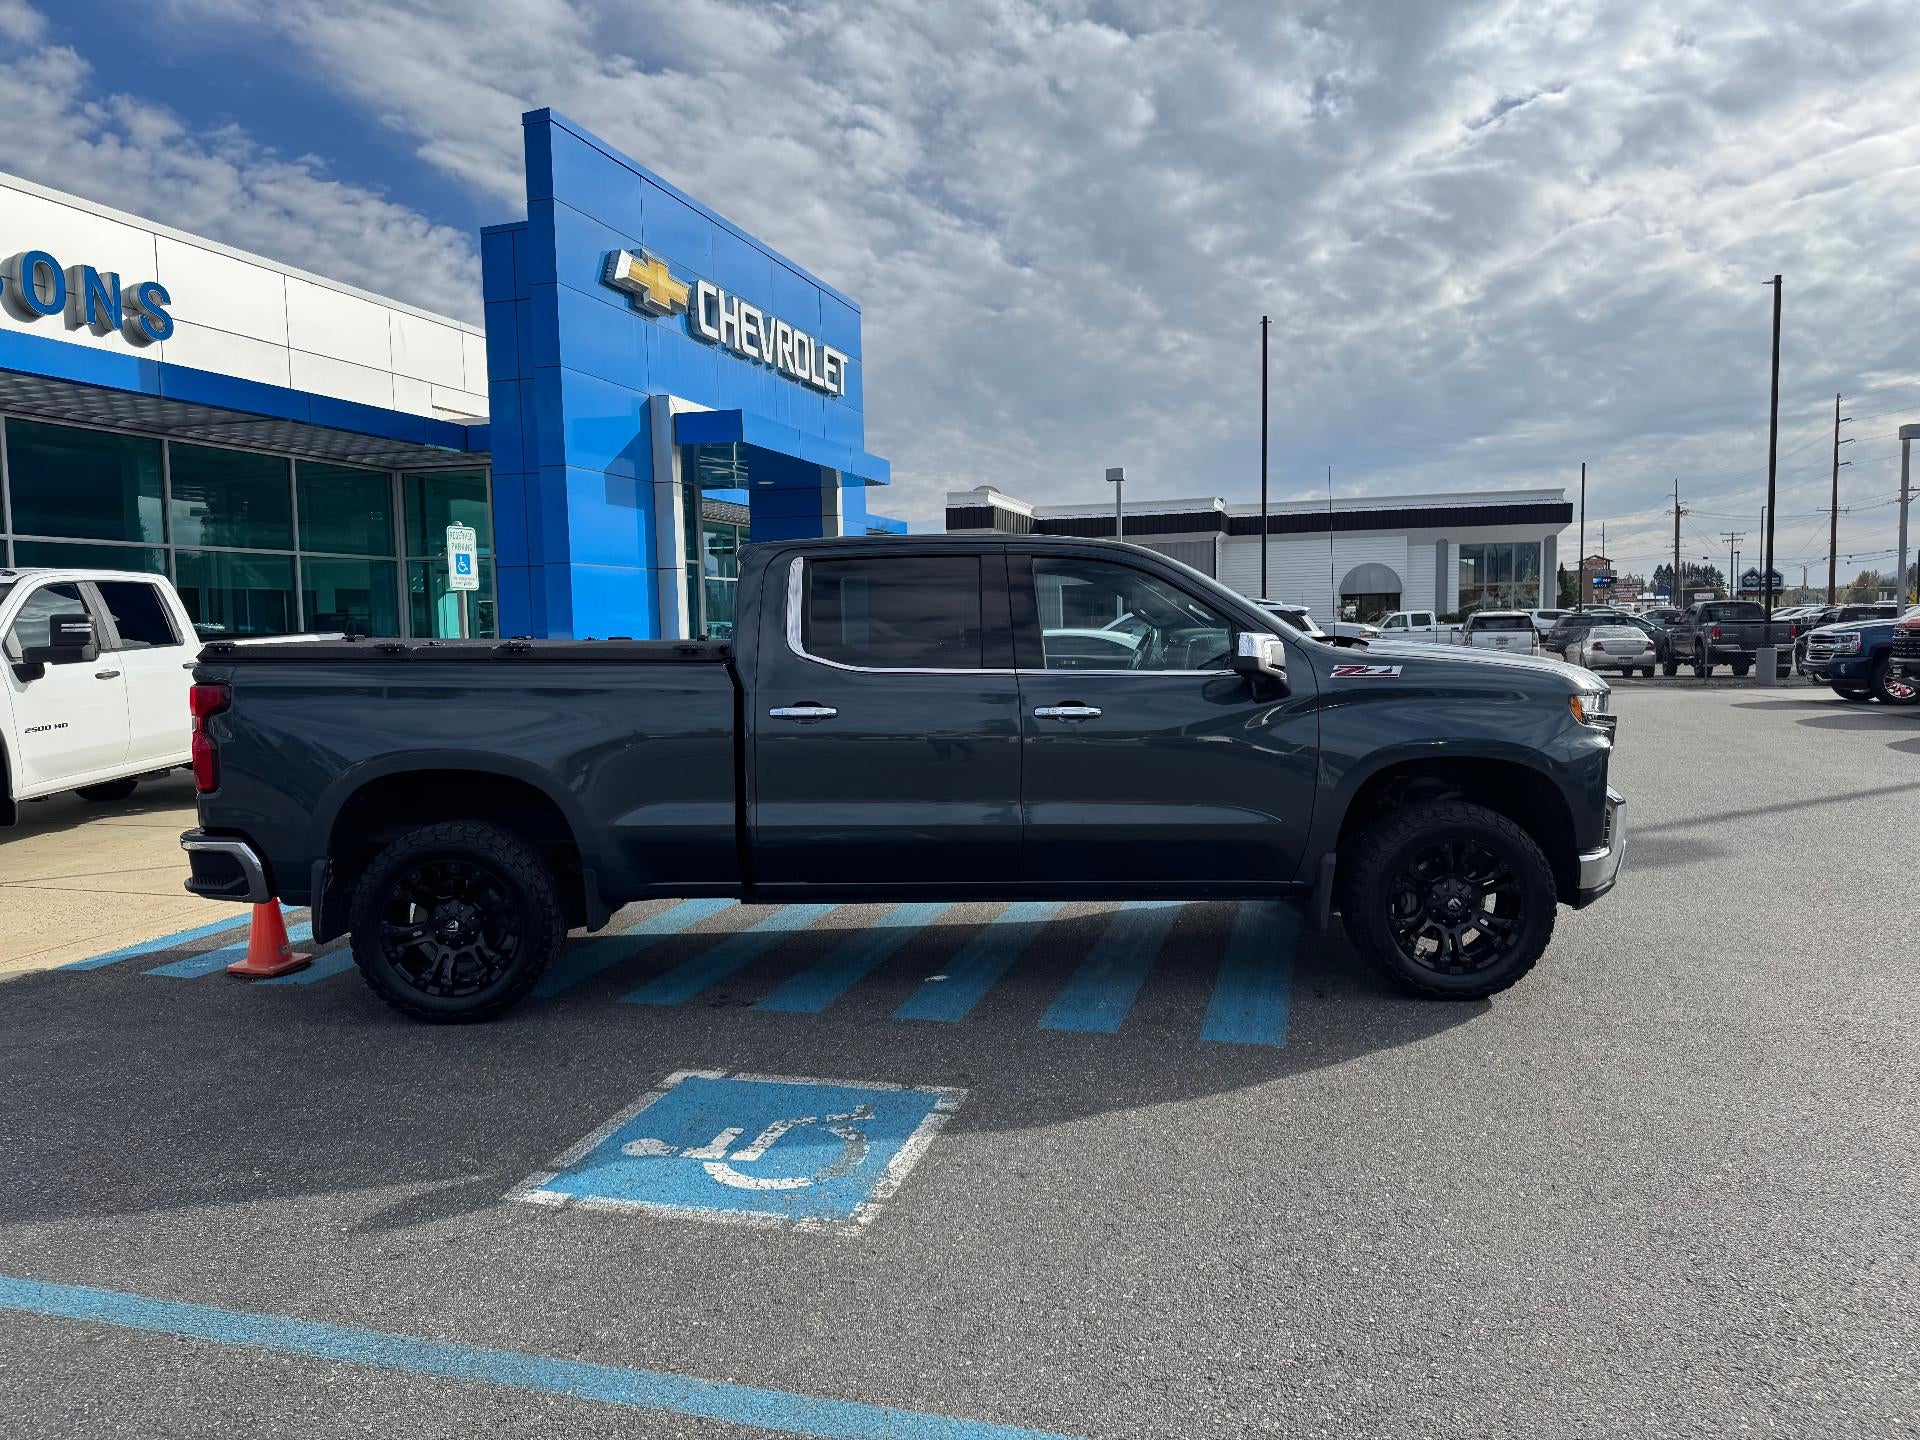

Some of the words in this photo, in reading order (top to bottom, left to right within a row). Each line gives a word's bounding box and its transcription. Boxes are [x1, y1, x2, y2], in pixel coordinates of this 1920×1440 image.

[0, 249, 175, 342] ONS
[696, 279, 850, 397] CHEVROLET
[449, 531, 473, 541] RESERVED
[451, 542, 473, 552] PARKING
[1329, 664, 1403, 679] Z71
[24, 724, 52, 734] 2500
[54, 722, 69, 730] HD
